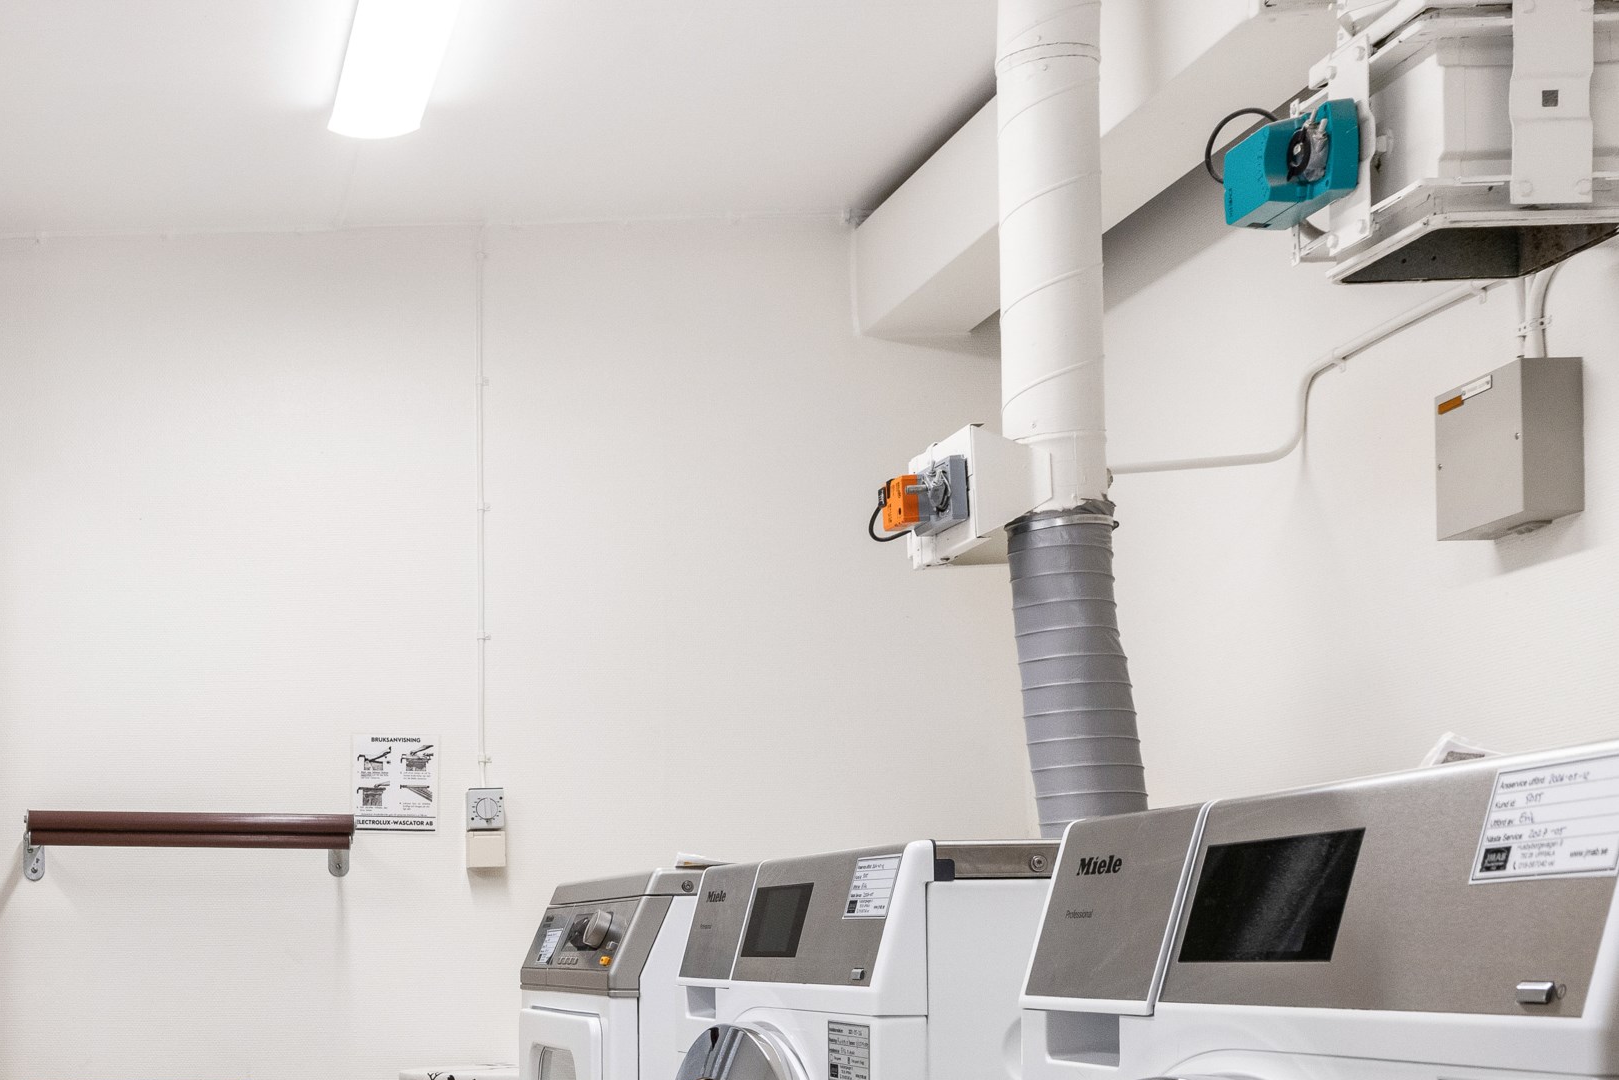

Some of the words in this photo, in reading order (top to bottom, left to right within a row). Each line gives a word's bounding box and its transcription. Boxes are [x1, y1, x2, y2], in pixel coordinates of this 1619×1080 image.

[1076, 854, 1123, 876] Miele
[706, 889, 727, 903] Miele
[1065, 909, 1094, 919] Professional
